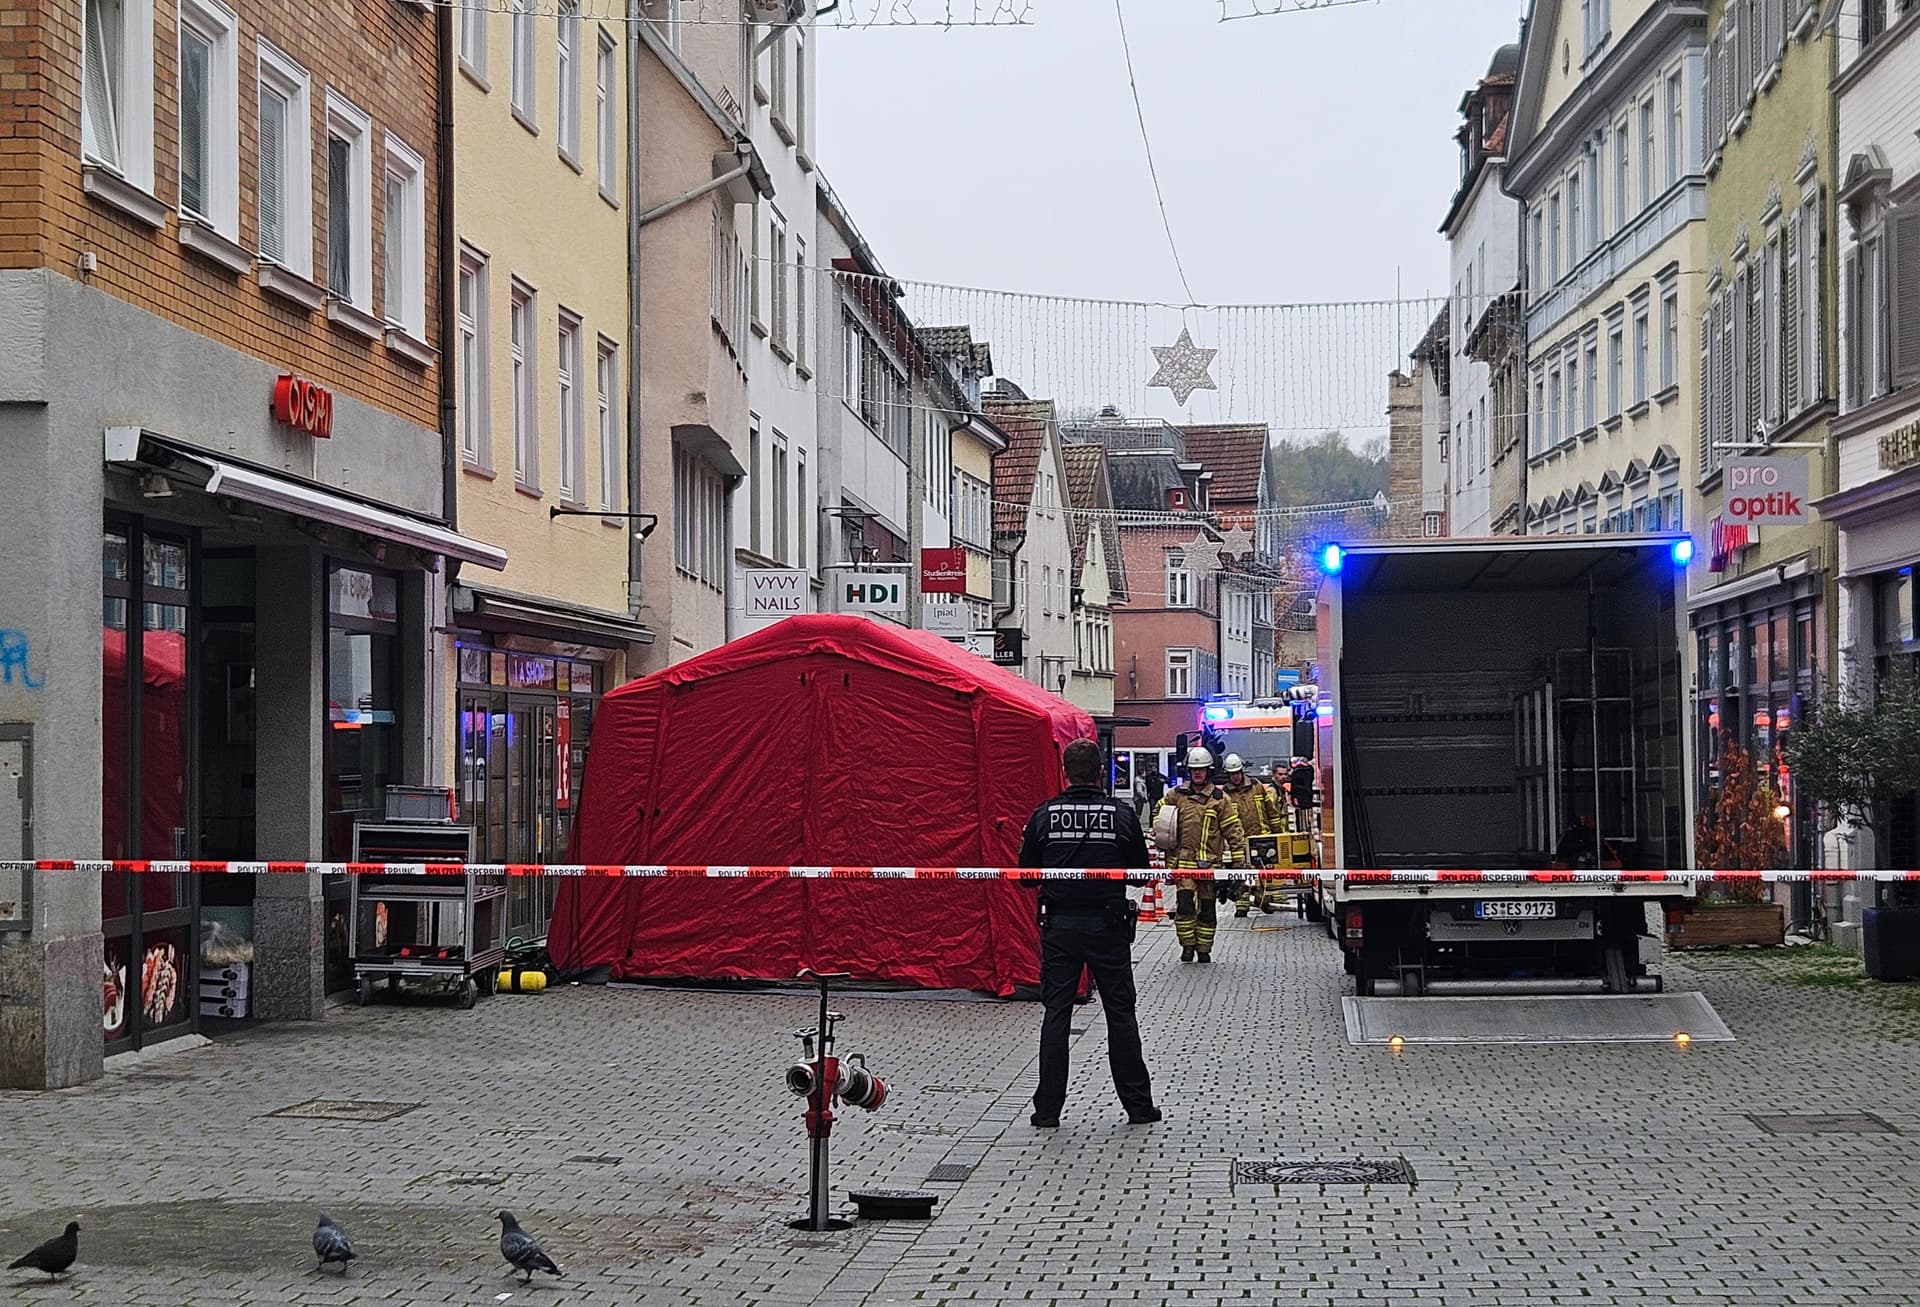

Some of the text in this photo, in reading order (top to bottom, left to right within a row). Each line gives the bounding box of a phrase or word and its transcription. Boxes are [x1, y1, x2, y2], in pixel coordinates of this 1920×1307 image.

[1730, 465, 1779, 491] pro
[1729, 491, 1802, 521] optik
[754, 576, 799, 590] VYVY
[846, 584, 898, 603] HDI
[754, 597, 801, 611] NAILS
[1050, 812, 1114, 830] POLIZEI
[144, 864, 227, 873] POLIZEIABSPERRUNG
[237, 865, 320, 874] POLIZEIABSPERRUNG
[332, 866, 415, 875] POLIZEIABSPERRUNG
[427, 867, 512, 876] POLIZEIABSPERRUNG
[523, 868, 608, 876] POLIZEIABSPERRUNG
[620, 868, 706, 877] POLIZEIABSPERRUNG
[718, 869, 806, 878] POLIZEIABSPERRUNG
[817, 870, 905, 878] POLIZEIABSPERRUNG
[918, 870, 1008, 879] POLIZEIABSPERRUNG
[1020, 871, 1111, 880] POLIZEIABSPERRUNG
[1123, 872, 1214, 880] POLIZEIABSPERRUNG
[1228, 872, 1320, 881] POLIZEIABSPERRUNG
[1334, 873, 1429, 881] POLIZEIABSPERRUNG
[1442, 873, 1539, 881] POLIZEIABSPERRUNG
[1552, 873, 1650, 881] POLIZEIABSPERRUNG
[1483, 902, 1554, 916] ES ES 9173
